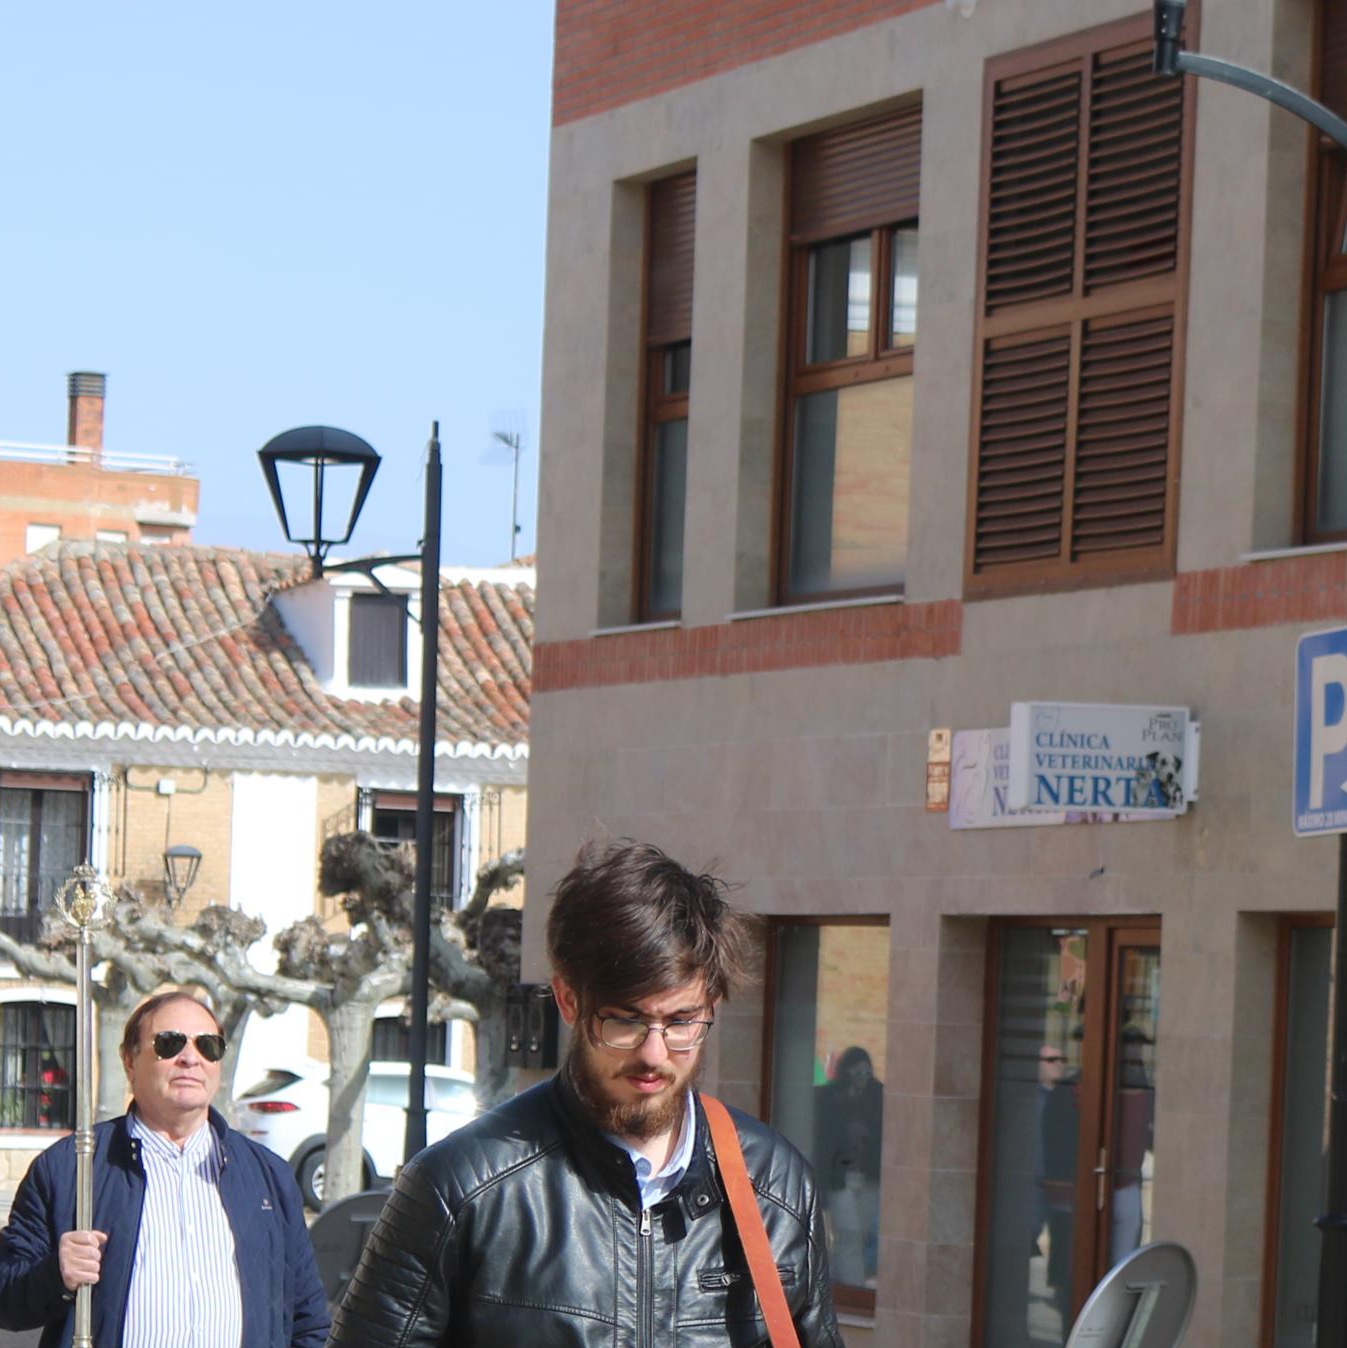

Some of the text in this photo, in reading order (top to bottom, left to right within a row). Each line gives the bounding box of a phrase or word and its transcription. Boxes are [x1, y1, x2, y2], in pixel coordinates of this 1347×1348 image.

[1149, 718, 1177, 731] PRO
[1036, 730, 1110, 749] CLÍNICA
[1035, 774, 1167, 807] NERTA
